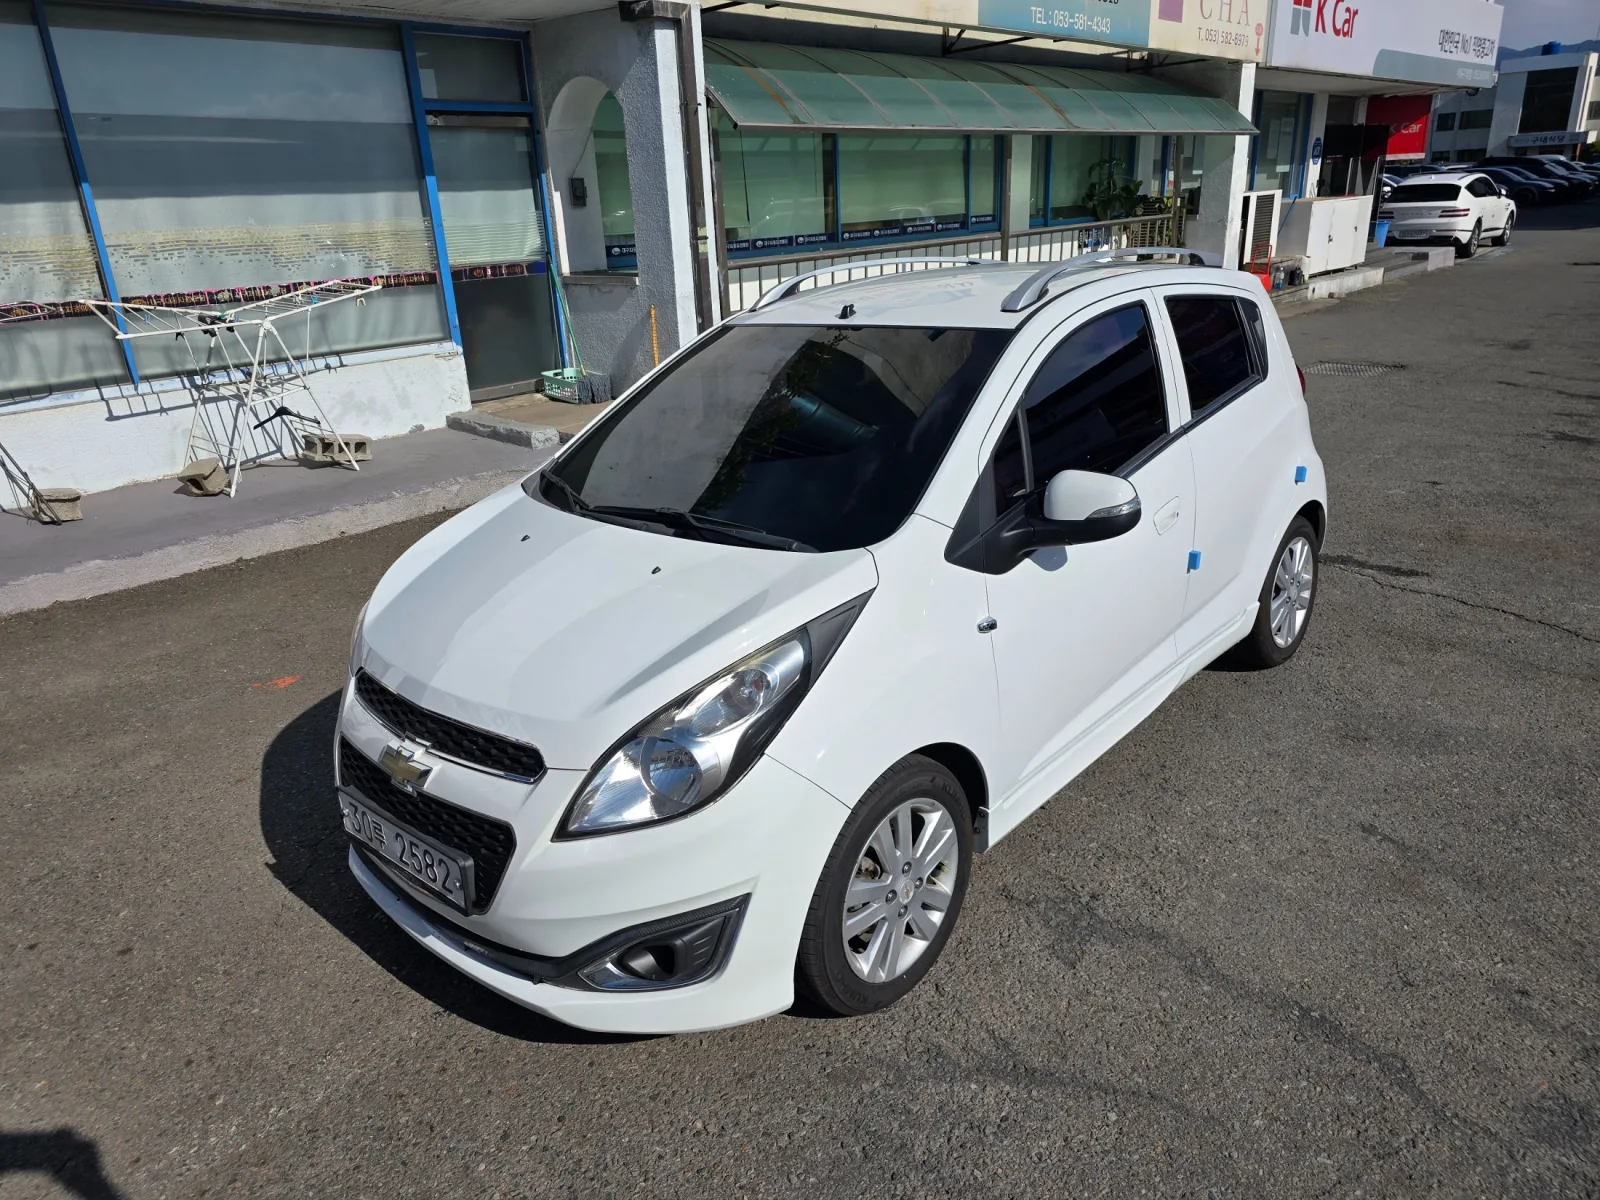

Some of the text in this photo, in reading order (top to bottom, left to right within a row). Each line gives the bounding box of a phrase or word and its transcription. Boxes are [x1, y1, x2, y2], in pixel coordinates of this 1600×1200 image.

[1053, 10, 1111, 34] 053-581-4343
[1315, 0, 1358, 38] K Car
[1438, 29, 1461, 54] 대한민국
[1400, 122, 1422, 134] Car
[1532, 134, 1565, 146] 구내식당
[395, 832, 454, 896] 2582
